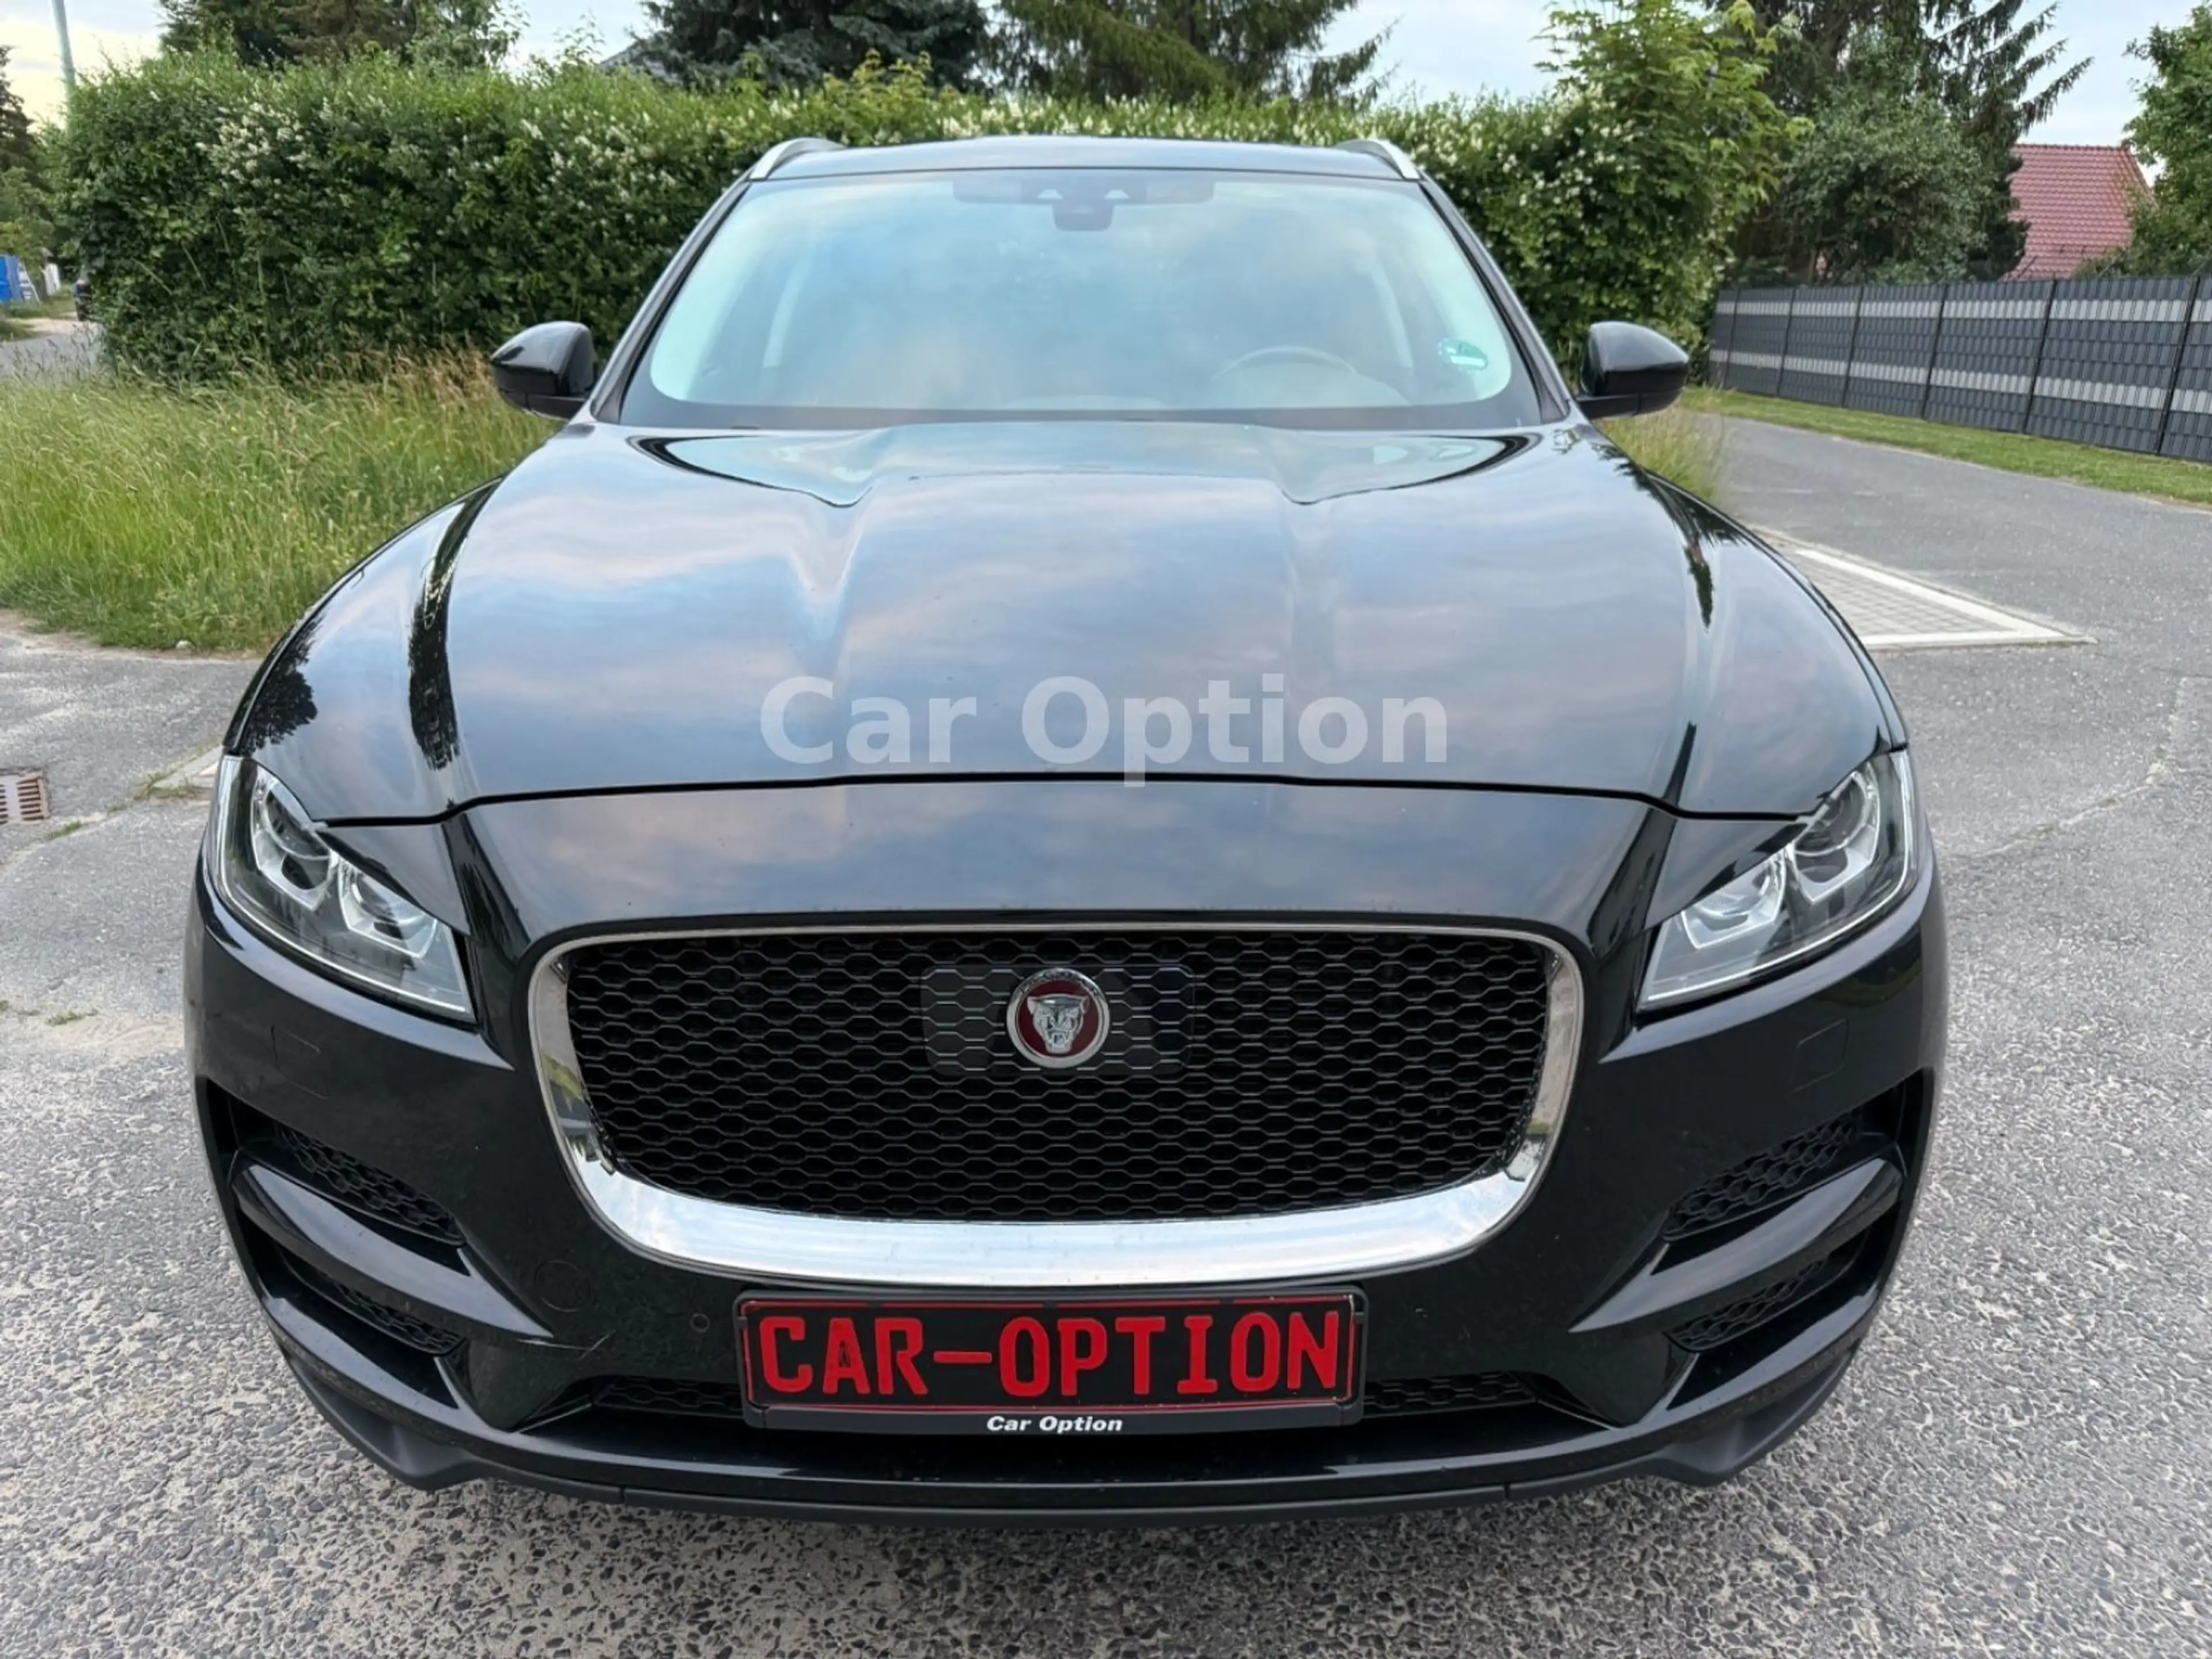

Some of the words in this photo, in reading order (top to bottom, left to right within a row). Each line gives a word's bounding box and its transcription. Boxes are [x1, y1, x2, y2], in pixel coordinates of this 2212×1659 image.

[759, 1311, 1339, 1397] CAR-OPTION
[986, 1415, 1032, 1431] Car
[1039, 1415, 1123, 1434] Option
